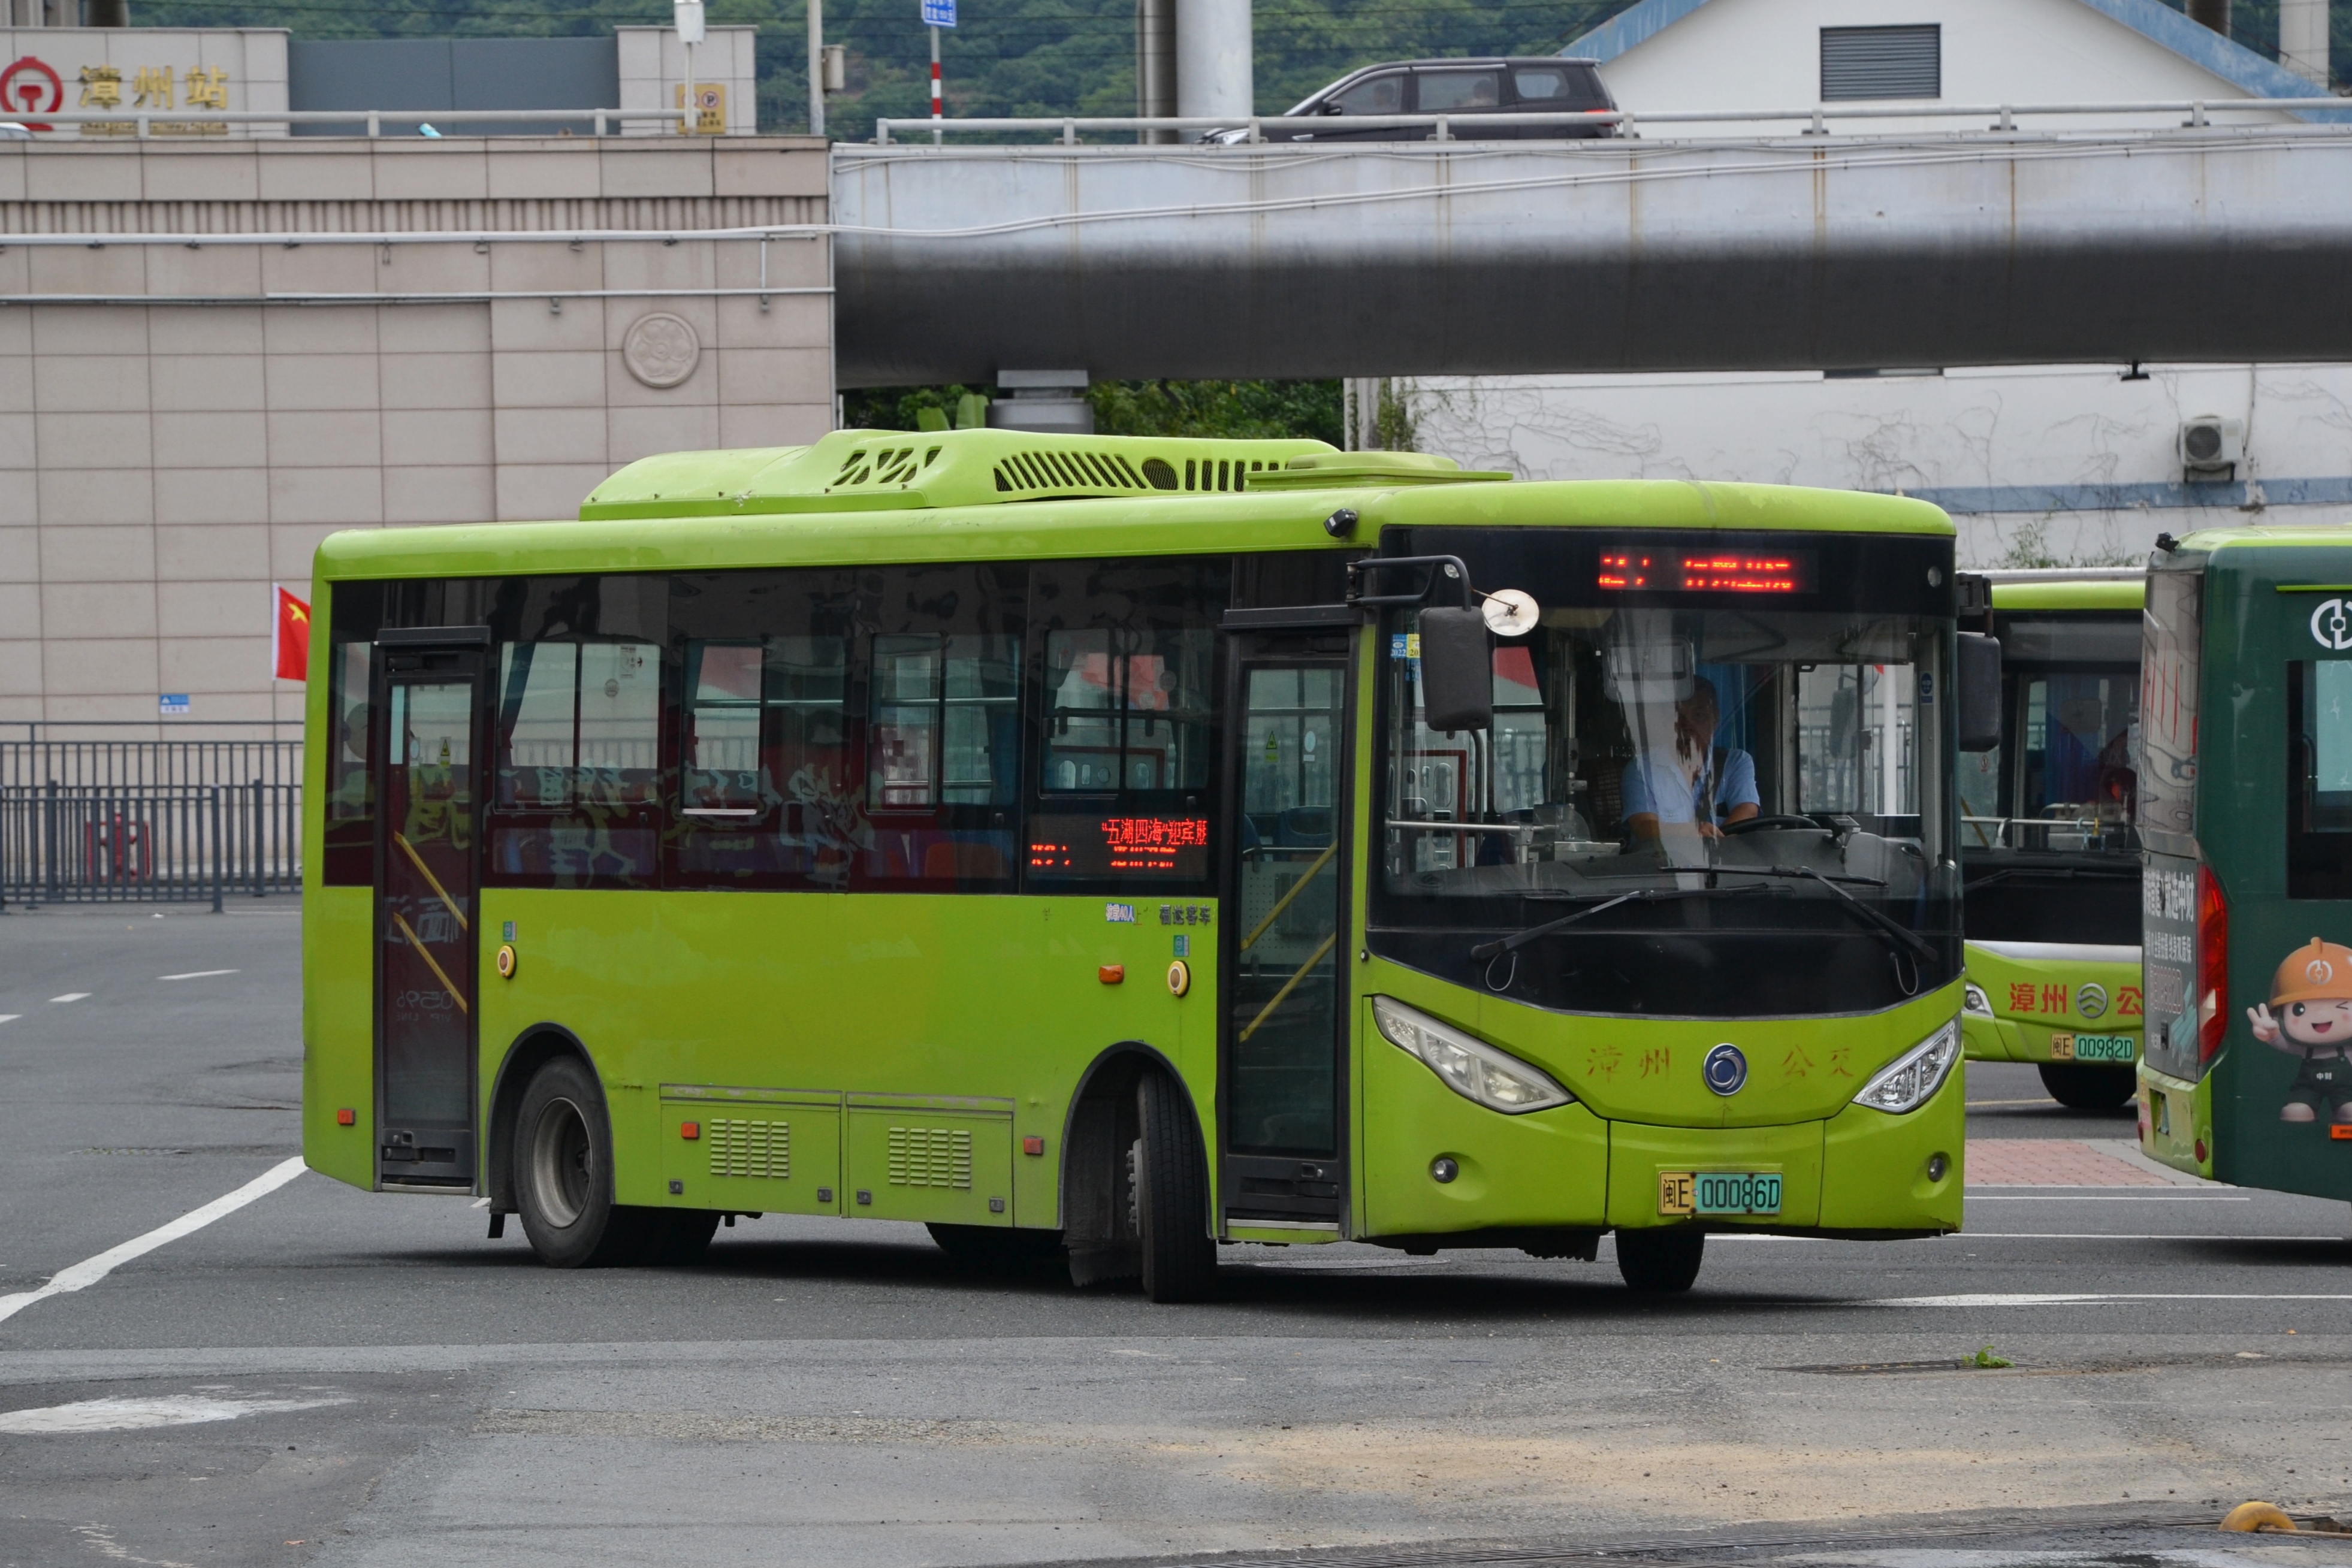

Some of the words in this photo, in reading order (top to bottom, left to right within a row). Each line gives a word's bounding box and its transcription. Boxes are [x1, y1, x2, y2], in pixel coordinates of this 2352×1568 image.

[78, 64, 228, 110] 漳州站
[1159, 904, 1211, 925] 福达客车
[2009, 983, 2067, 1014] 漳州
[2052, 1037, 2133, 1058] 闽E00982D
[1587, 1045, 1671, 1083] 漳州
[1782, 1044, 1854, 1079] 公交
[1663, 1179, 1780, 1209] 闽E00086D
